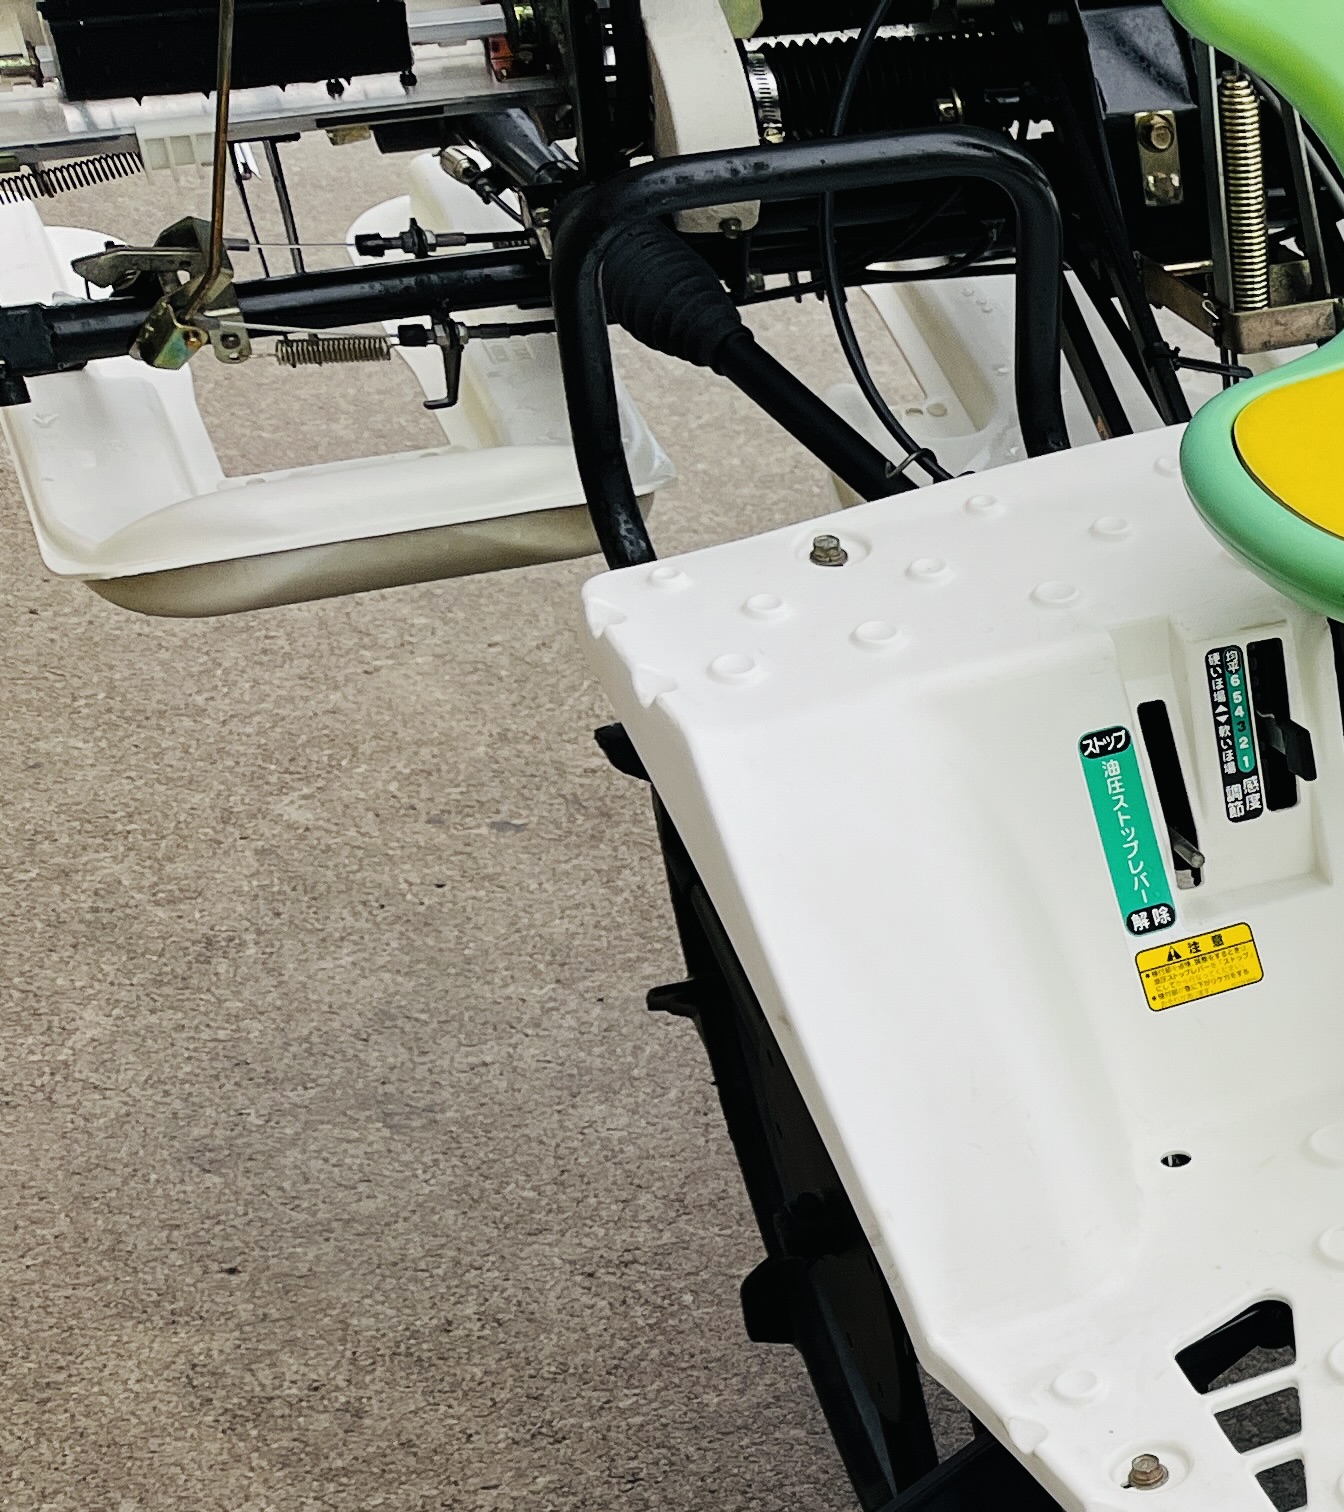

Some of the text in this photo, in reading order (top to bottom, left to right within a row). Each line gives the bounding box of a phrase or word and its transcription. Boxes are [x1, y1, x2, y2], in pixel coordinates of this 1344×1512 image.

[1226, 650, 1240, 674] 均平
[1230, 674, 1250, 768] 6 5 4 3 2 1
[1081, 729, 1126, 756] ストップ
[1225, 783, 1245, 818] 調節
[1242, 775, 1262, 811] 感度
[1101, 759, 1150, 904] 油圧ストップレバー
[1130, 906, 1172, 932] 解除
[1187, 933, 1225, 954] 注意
